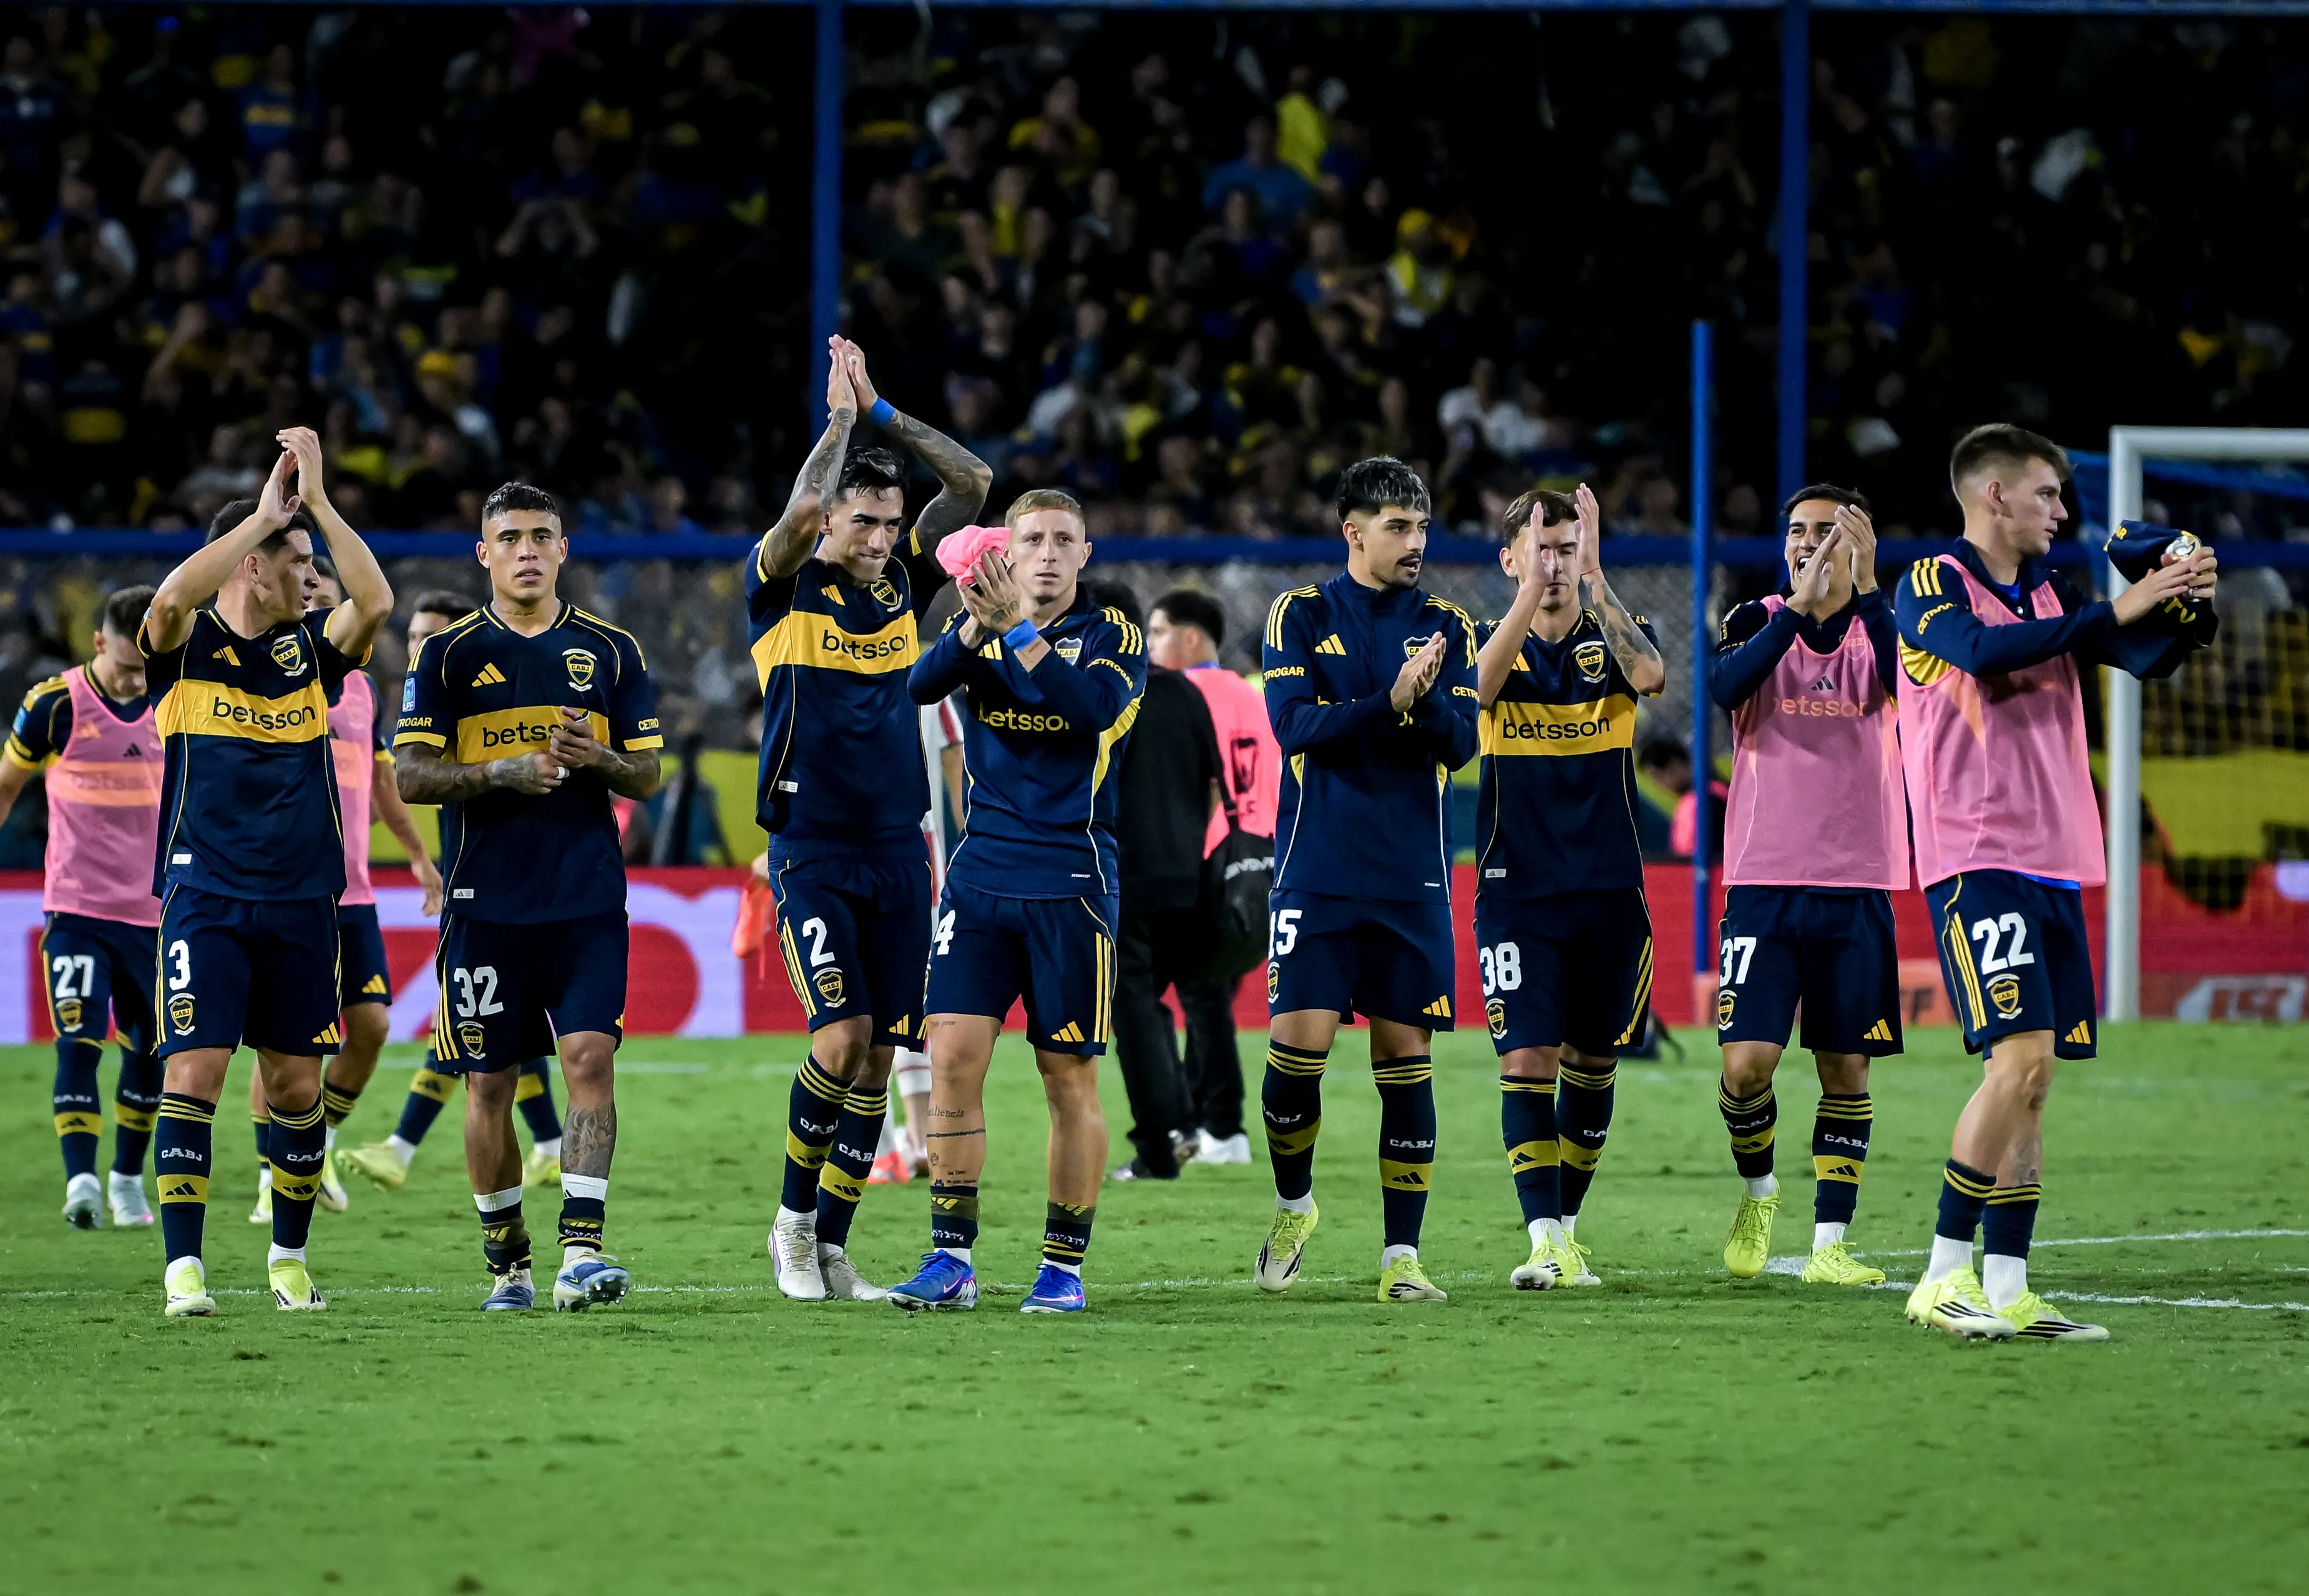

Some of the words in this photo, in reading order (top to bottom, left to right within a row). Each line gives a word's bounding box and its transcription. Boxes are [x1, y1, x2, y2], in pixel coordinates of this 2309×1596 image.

[877, 586, 891, 598] CABJ
[823, 629, 908, 659] btsso
[278, 648, 296, 661] CABJ
[1582, 656, 1599, 665] CABJ
[572, 664, 590, 672] CABJ
[1264, 666, 1304, 681] TROGAR
[213, 696, 316, 731] betsson
[403, 700, 414, 711] LPF
[1777, 696, 1865, 718] etsso
[398, 717, 432, 729] TROGAR
[638, 718, 659, 731] CETRO
[1503, 717, 1610, 740] betsson
[482, 721, 562, 747] betss
[803, 917, 834, 967] 2
[1268, 909, 1302, 960] 15
[1972, 912, 2035, 975] 22
[169, 939, 190, 991] 3
[1480, 942, 1521, 996] 38
[1719, 937, 1757, 986] 37
[53, 955, 94, 998] 27
[454, 966, 504, 1017] 32
[822, 982, 840, 991] CABJ
[1996, 991, 2015, 1000] CABJ
[174, 1007, 190, 1019] CABJ
[1390, 1139, 1433, 1148] CABJ
[1824, 1134, 1868, 1149] CABJ
[162, 1148, 202, 1161] CABJ
[839, 1143, 874, 1162] CAB
